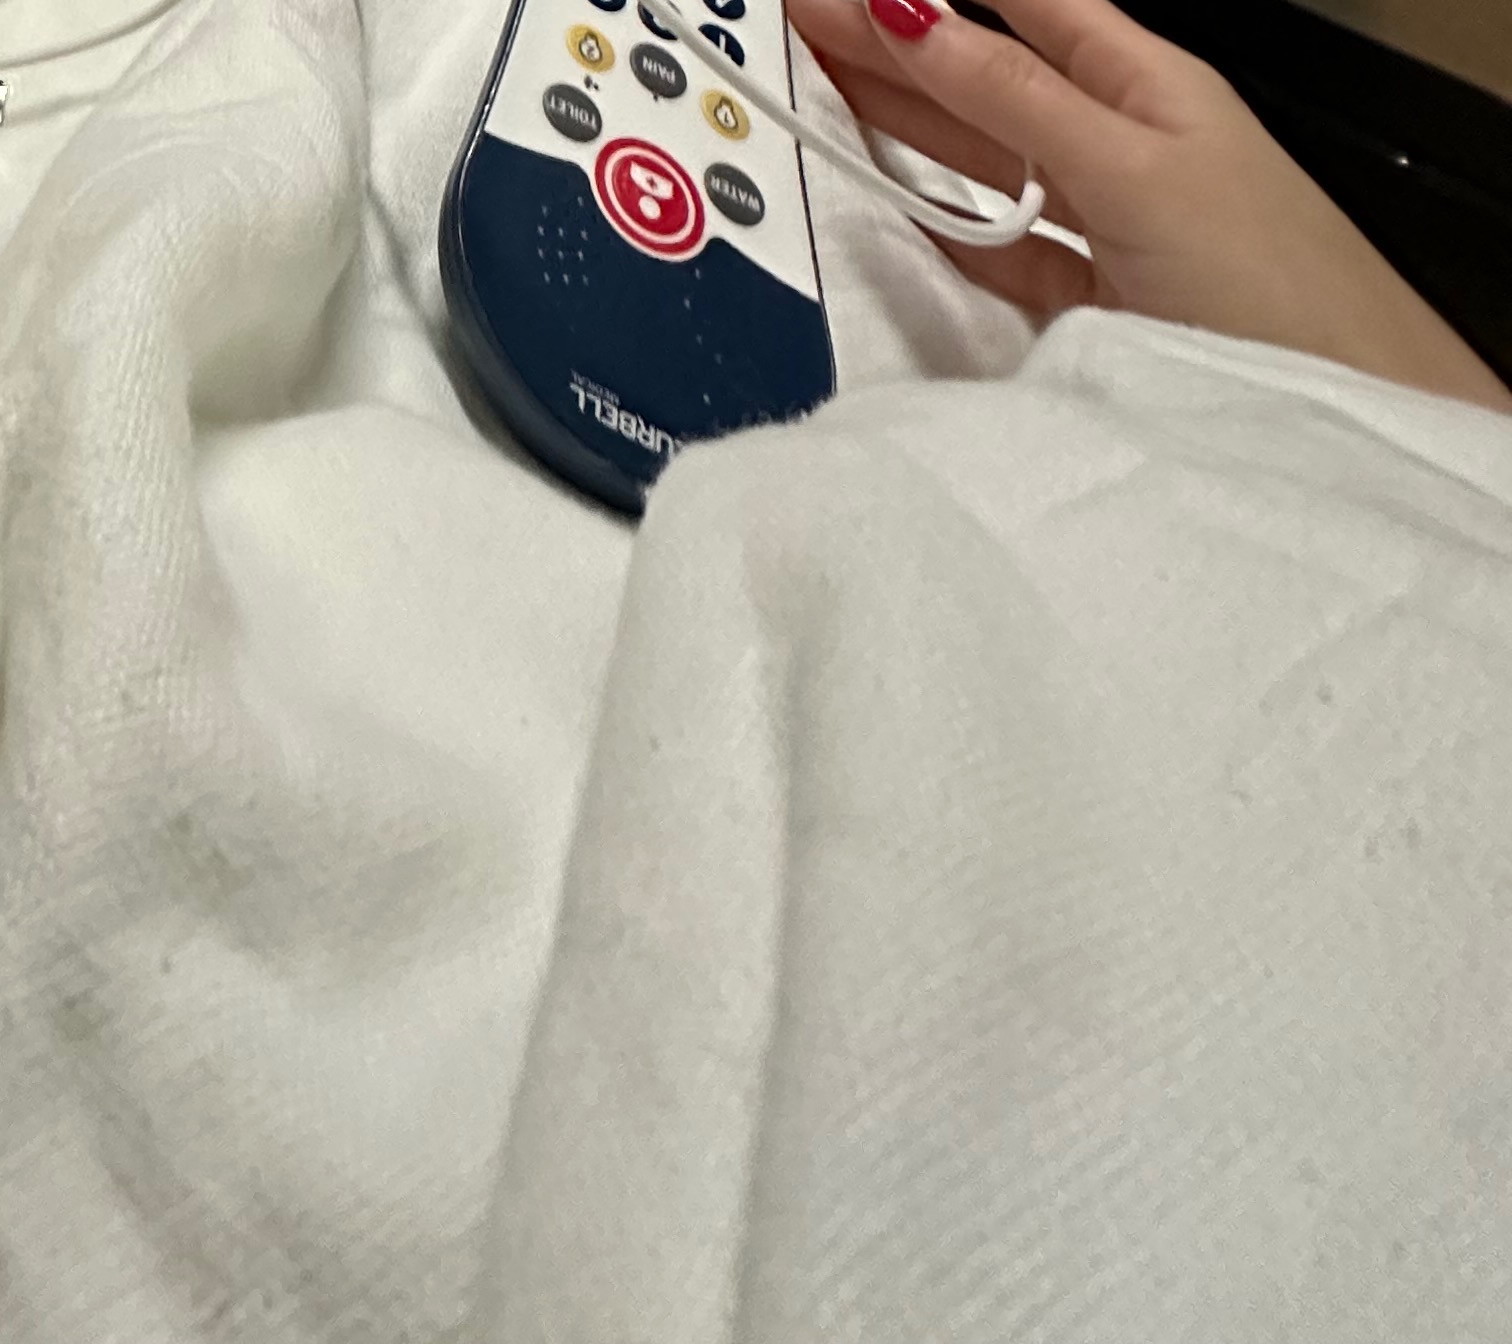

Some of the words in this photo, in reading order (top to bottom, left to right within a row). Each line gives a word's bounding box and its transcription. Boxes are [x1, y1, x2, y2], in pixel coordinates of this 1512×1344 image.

[642, 56, 676, 85] PAIN
[549, 94, 598, 131] TOILET
[710, 175, 760, 213] WATER
